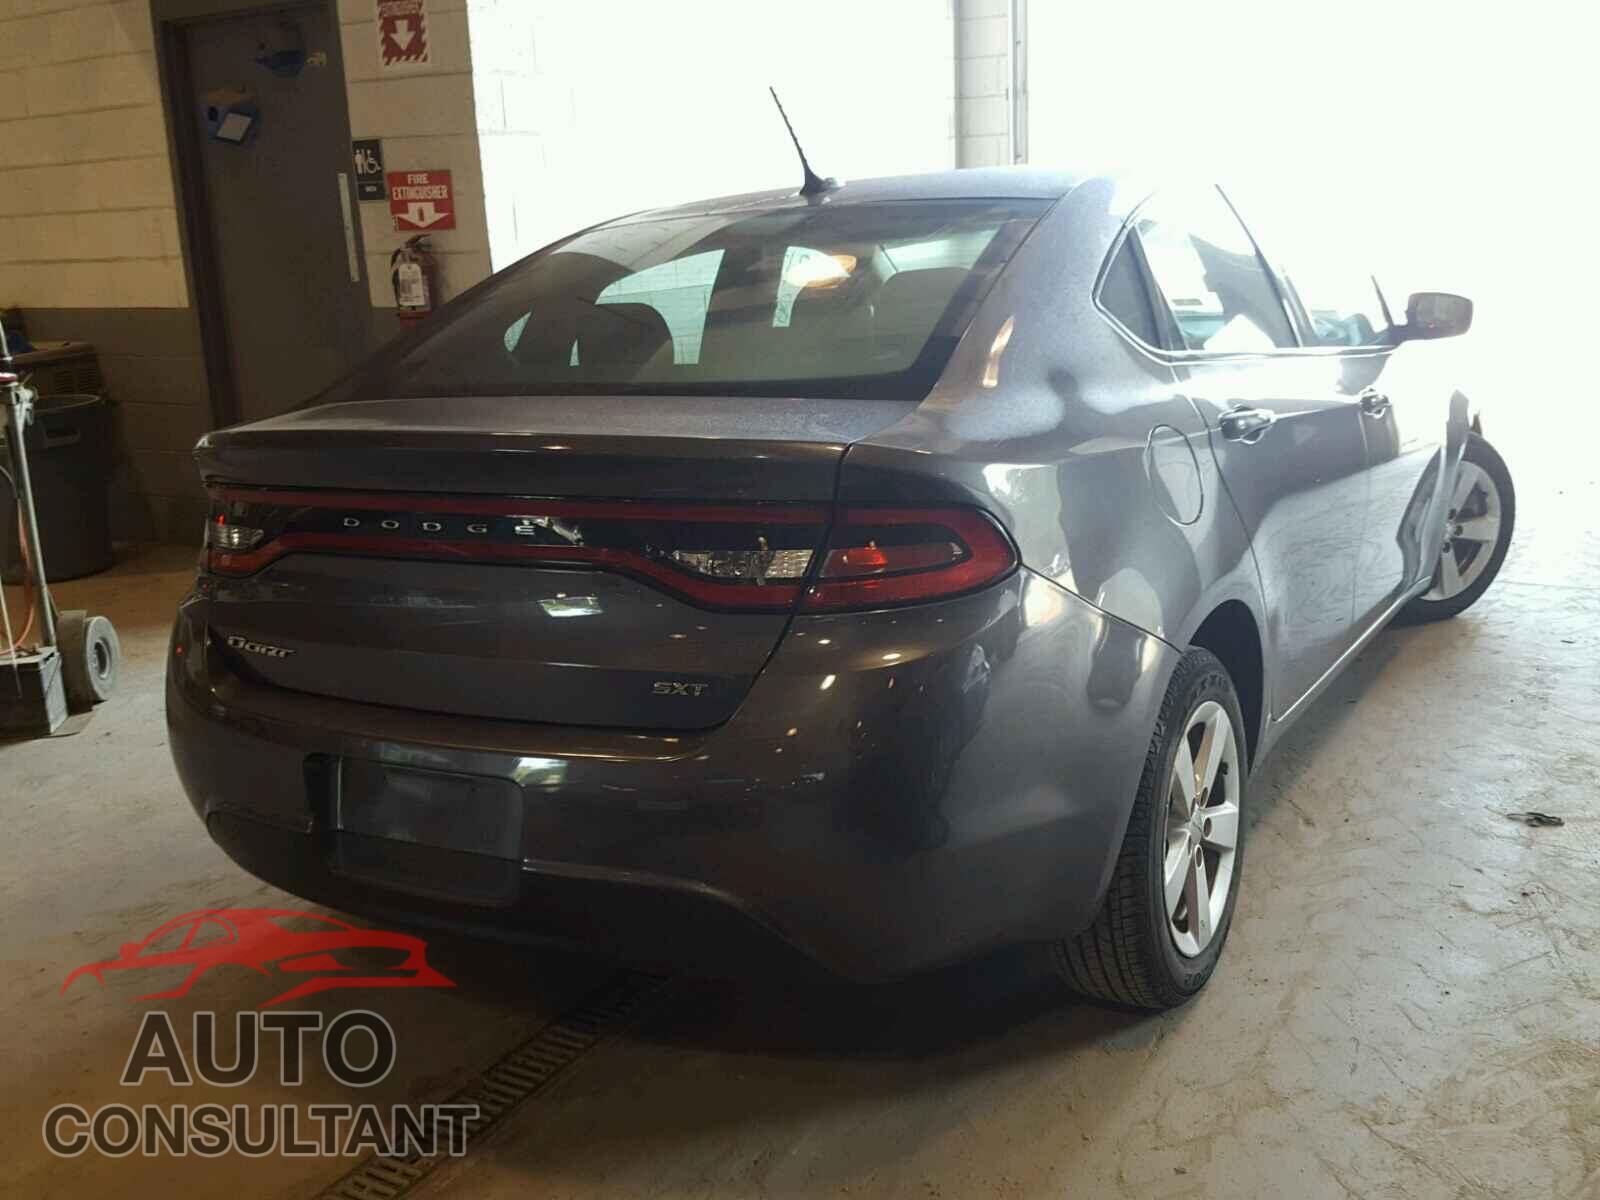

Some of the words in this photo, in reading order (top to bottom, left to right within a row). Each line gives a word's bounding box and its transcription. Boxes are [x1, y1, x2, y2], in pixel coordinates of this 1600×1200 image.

[407, 173, 429, 185] FIRE
[392, 185, 448, 201] EXTINGUISHER
[342, 516, 536, 536] DODGE
[651, 681, 709, 697] SXT
